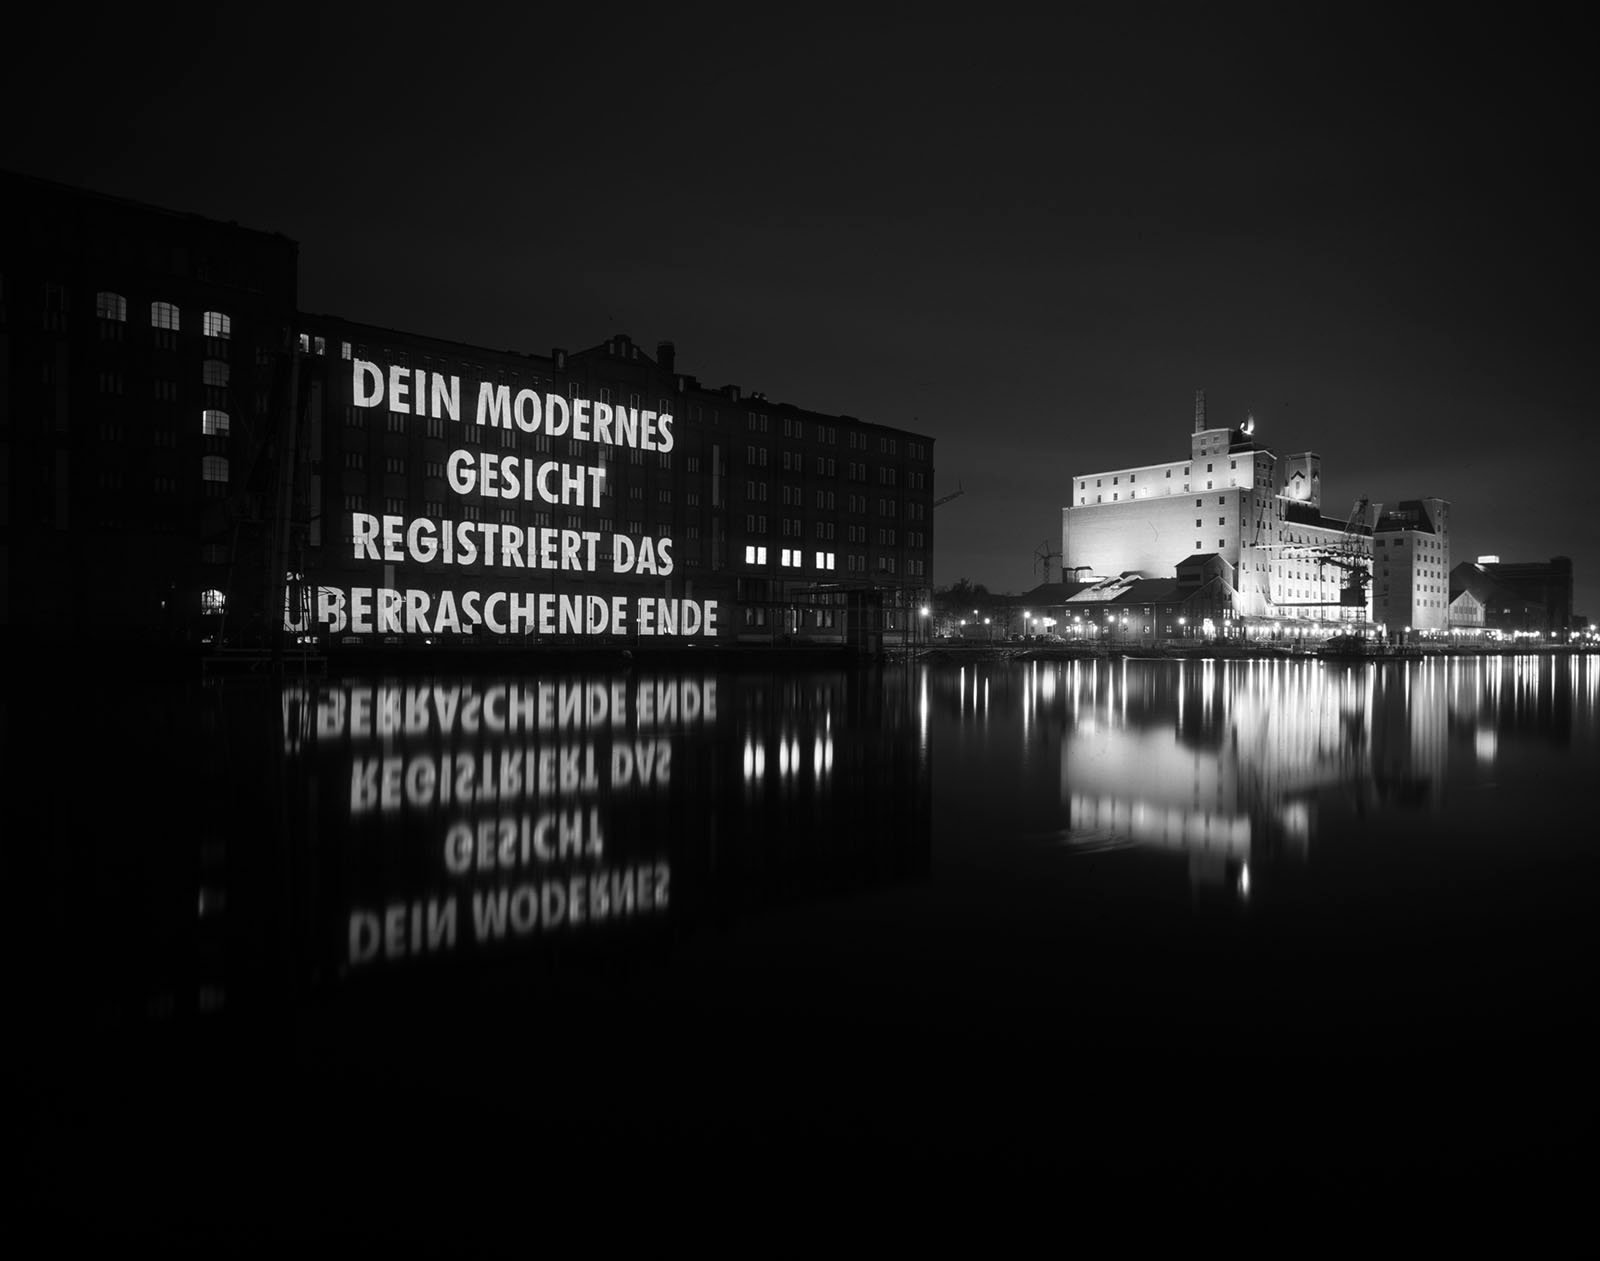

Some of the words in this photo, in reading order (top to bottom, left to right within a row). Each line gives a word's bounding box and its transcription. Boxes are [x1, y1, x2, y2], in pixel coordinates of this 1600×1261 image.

[353, 358, 460, 421] DEIN
[476, 382, 673, 453] MODERNES
[447, 449, 606, 508] GESICHT
[352, 512, 600, 571] REGISTRIERT
[613, 534, 673, 576] DAS
[639, 598, 717, 636] ENDE
